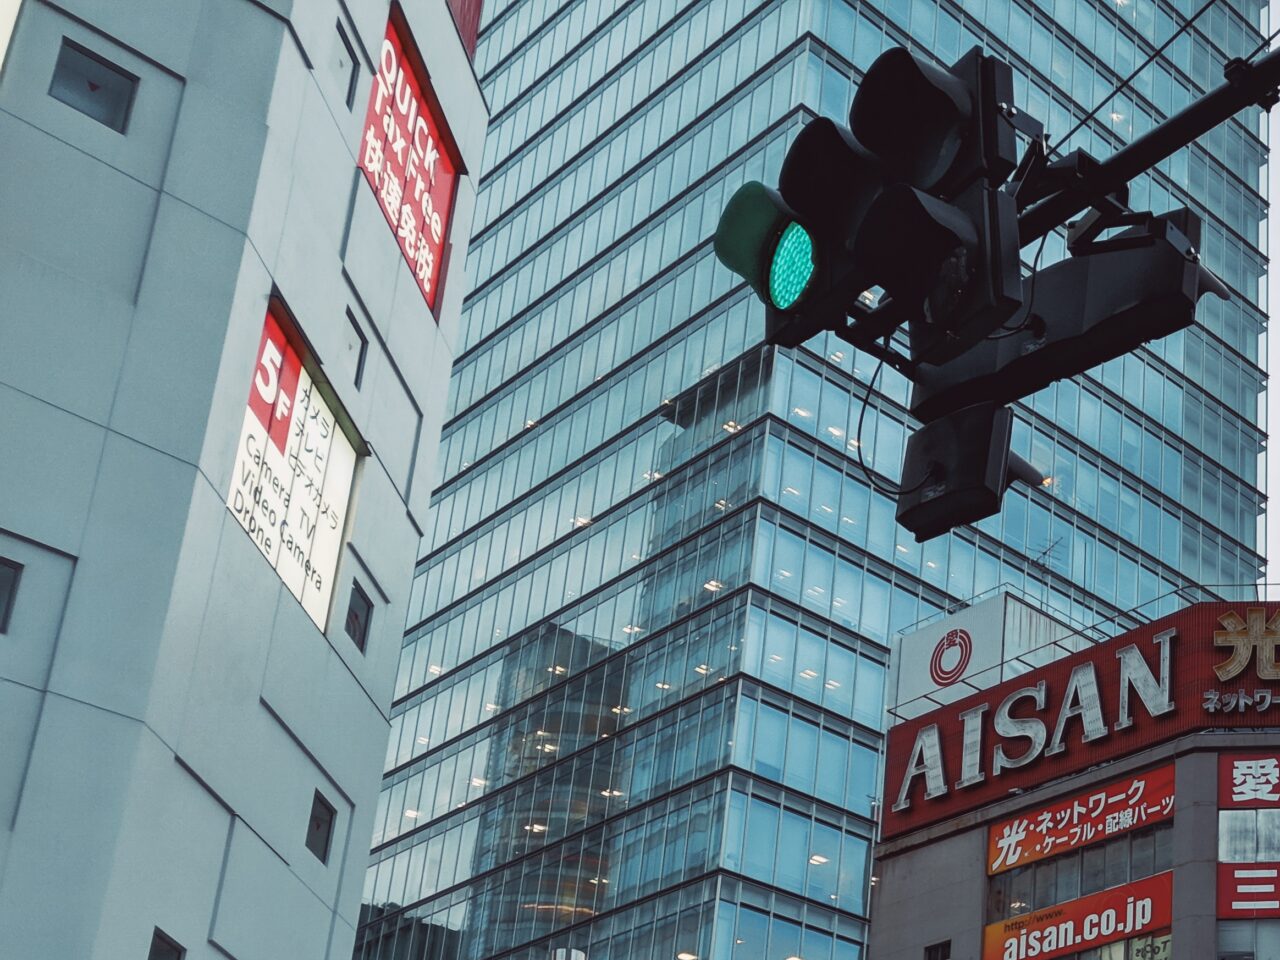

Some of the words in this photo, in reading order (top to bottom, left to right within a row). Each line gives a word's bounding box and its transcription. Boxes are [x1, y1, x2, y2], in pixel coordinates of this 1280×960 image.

[374, 71, 406, 167] Tax
[405, 143, 443, 244] Free
[380, 39, 440, 186] QUICK
[254, 338, 291, 422] 5F
[299, 387, 331, 440] カメラ
[245, 433, 291, 509] Camera
[299, 506, 317, 541] TV
[293, 420, 324, 474] テレビ
[232, 487, 273, 556] Drone
[240, 460, 277, 529] Video
[279, 519, 323, 593] Camera
[891, 627, 1177, 813] AISAN
[992, 819, 1028, 871] 光
